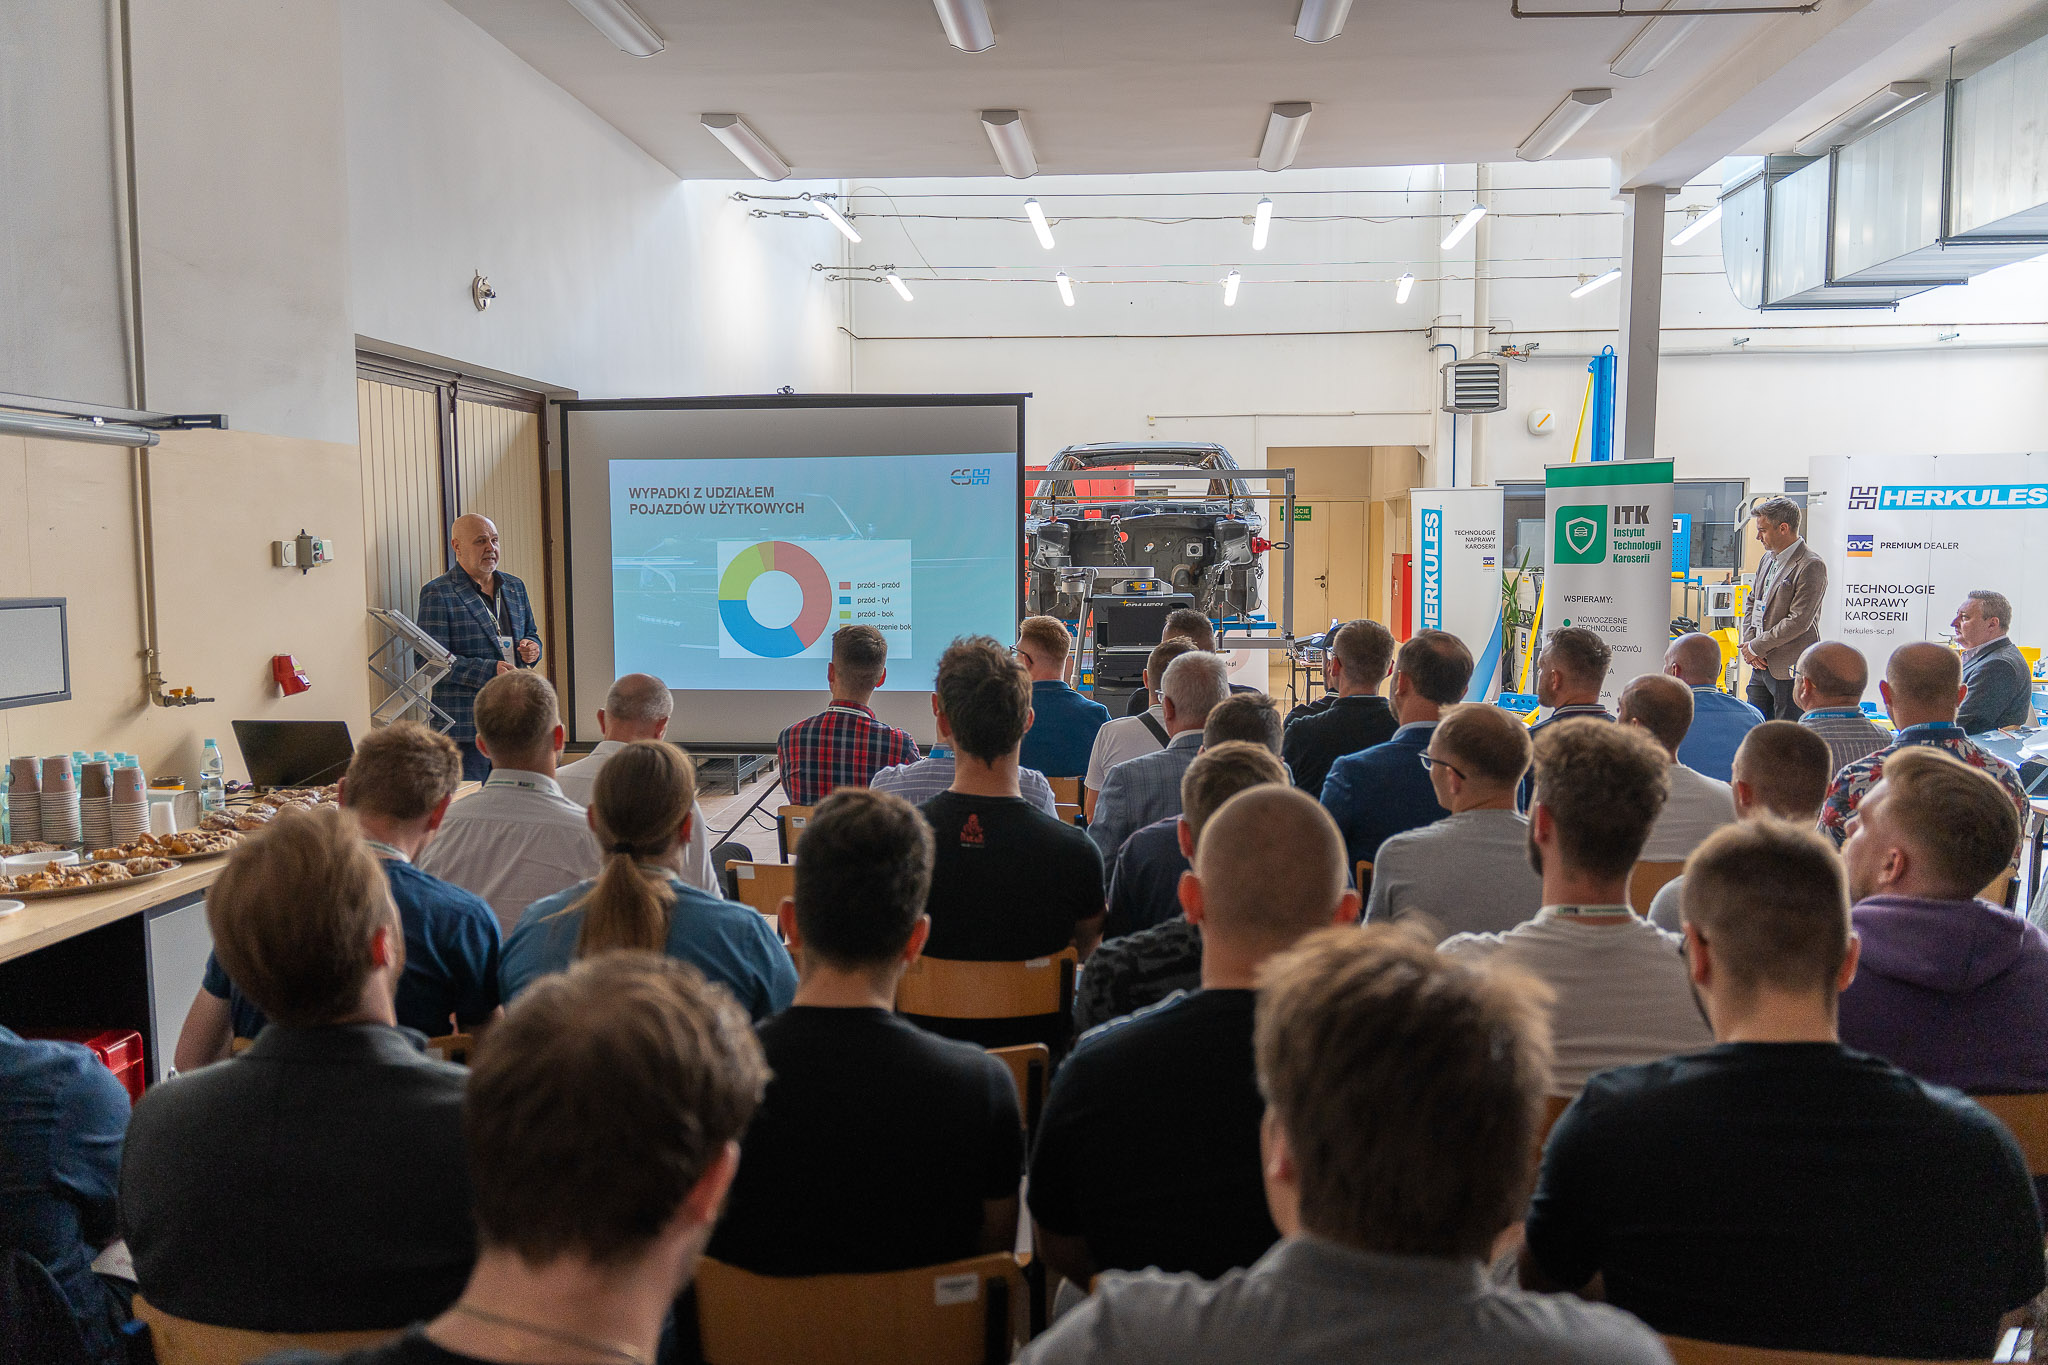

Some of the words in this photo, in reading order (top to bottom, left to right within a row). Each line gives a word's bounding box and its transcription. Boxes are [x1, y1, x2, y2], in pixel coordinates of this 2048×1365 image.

[629, 487, 690, 499] WYPADKI
[693, 487, 702, 498] Z
[706, 486, 775, 499] UDZIAŁEM
[1882, 488, 2048, 506] HERKULES
[629, 501, 706, 515] POJAZDÓW
[709, 501, 805, 515] UŻYTKOWYCH
[1614, 505, 1650, 525] ITK
[1613, 528, 1645, 538] Instytut
[1613, 541, 1662, 551] Technologii
[1848, 540, 1874, 550] GYS
[1880, 542, 1921, 550] PREMIUM
[1923, 542, 1959, 550] DEALER
[1612, 553, 1650, 563] Karoserii
[1846, 584, 1936, 595] TECHNOLOGIE
[1563, 595, 1613, 604] WSPIERAMY:
[1845, 597, 1909, 608] NAPRAWY
[1577, 616, 1628, 625] NOWOCZESNE
[1845, 611, 1909, 622] KAROSERII
[1843, 627, 1895, 636] herkules-sc.pl
[1611, 645, 1642, 653] ROZWÓJ
